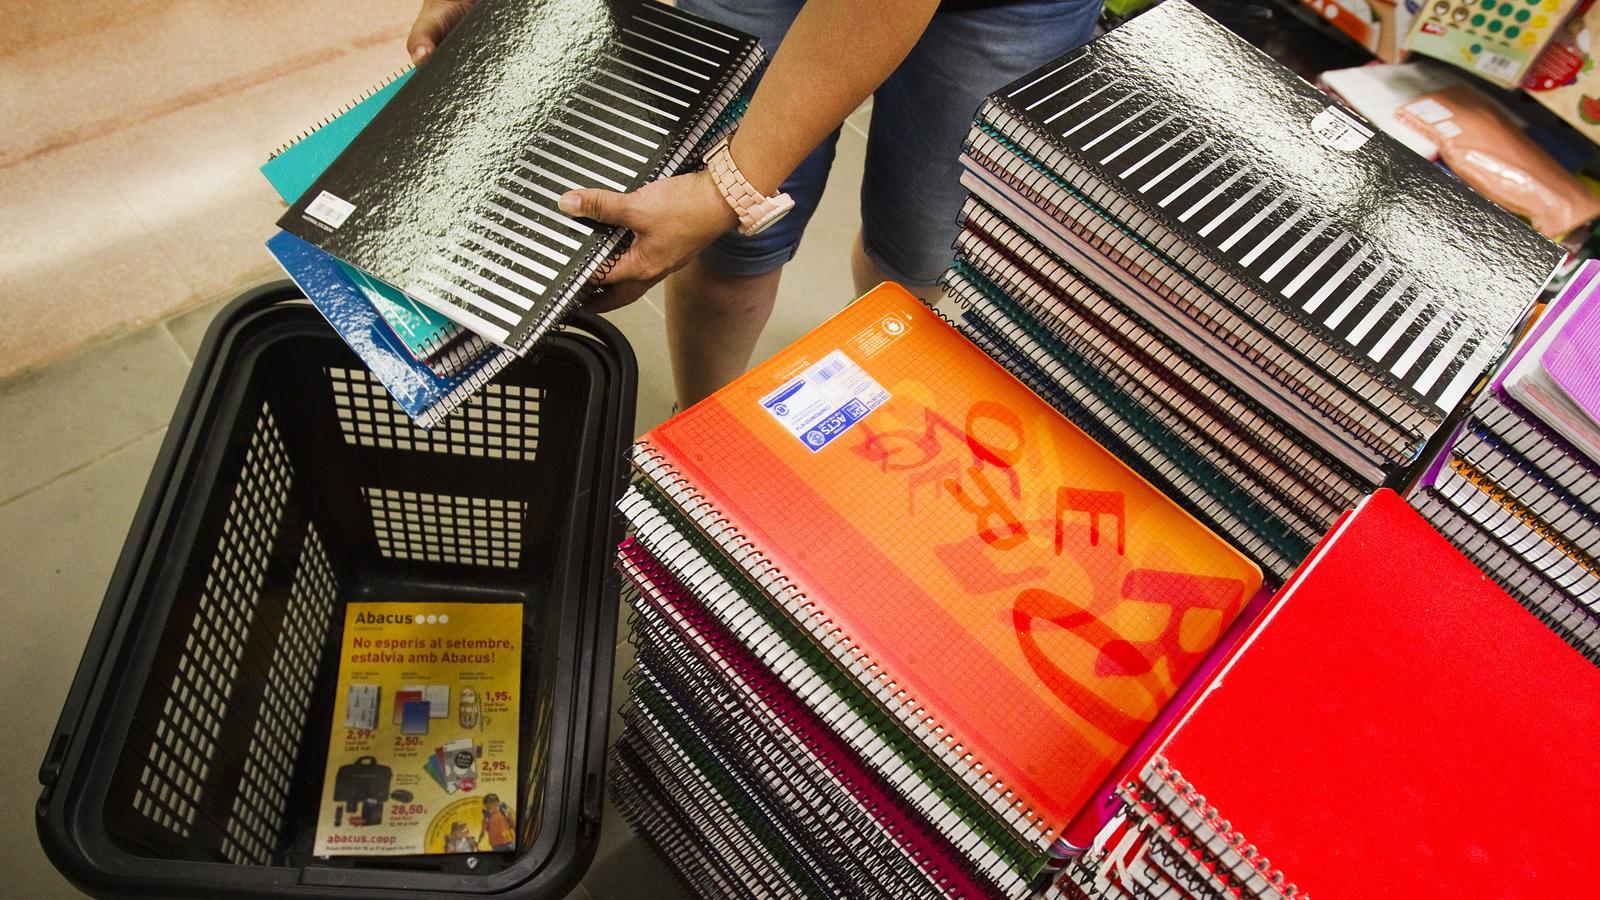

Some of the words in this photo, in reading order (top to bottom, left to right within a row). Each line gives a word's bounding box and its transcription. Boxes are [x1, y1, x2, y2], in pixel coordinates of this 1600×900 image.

[819, 412, 848, 436] ACTS
[354, 611, 413, 624] Abacus
[353, 637, 371, 648] No
[375, 637, 426, 650] esperis
[430, 637, 441, 649] al
[446, 637, 514, 650] setembre,
[352, 652, 404, 663] estalvia
[408, 652, 437, 663] amb
[441, 652, 495, 663] Abacus!
[327, 834, 397, 846] abacus.coop
